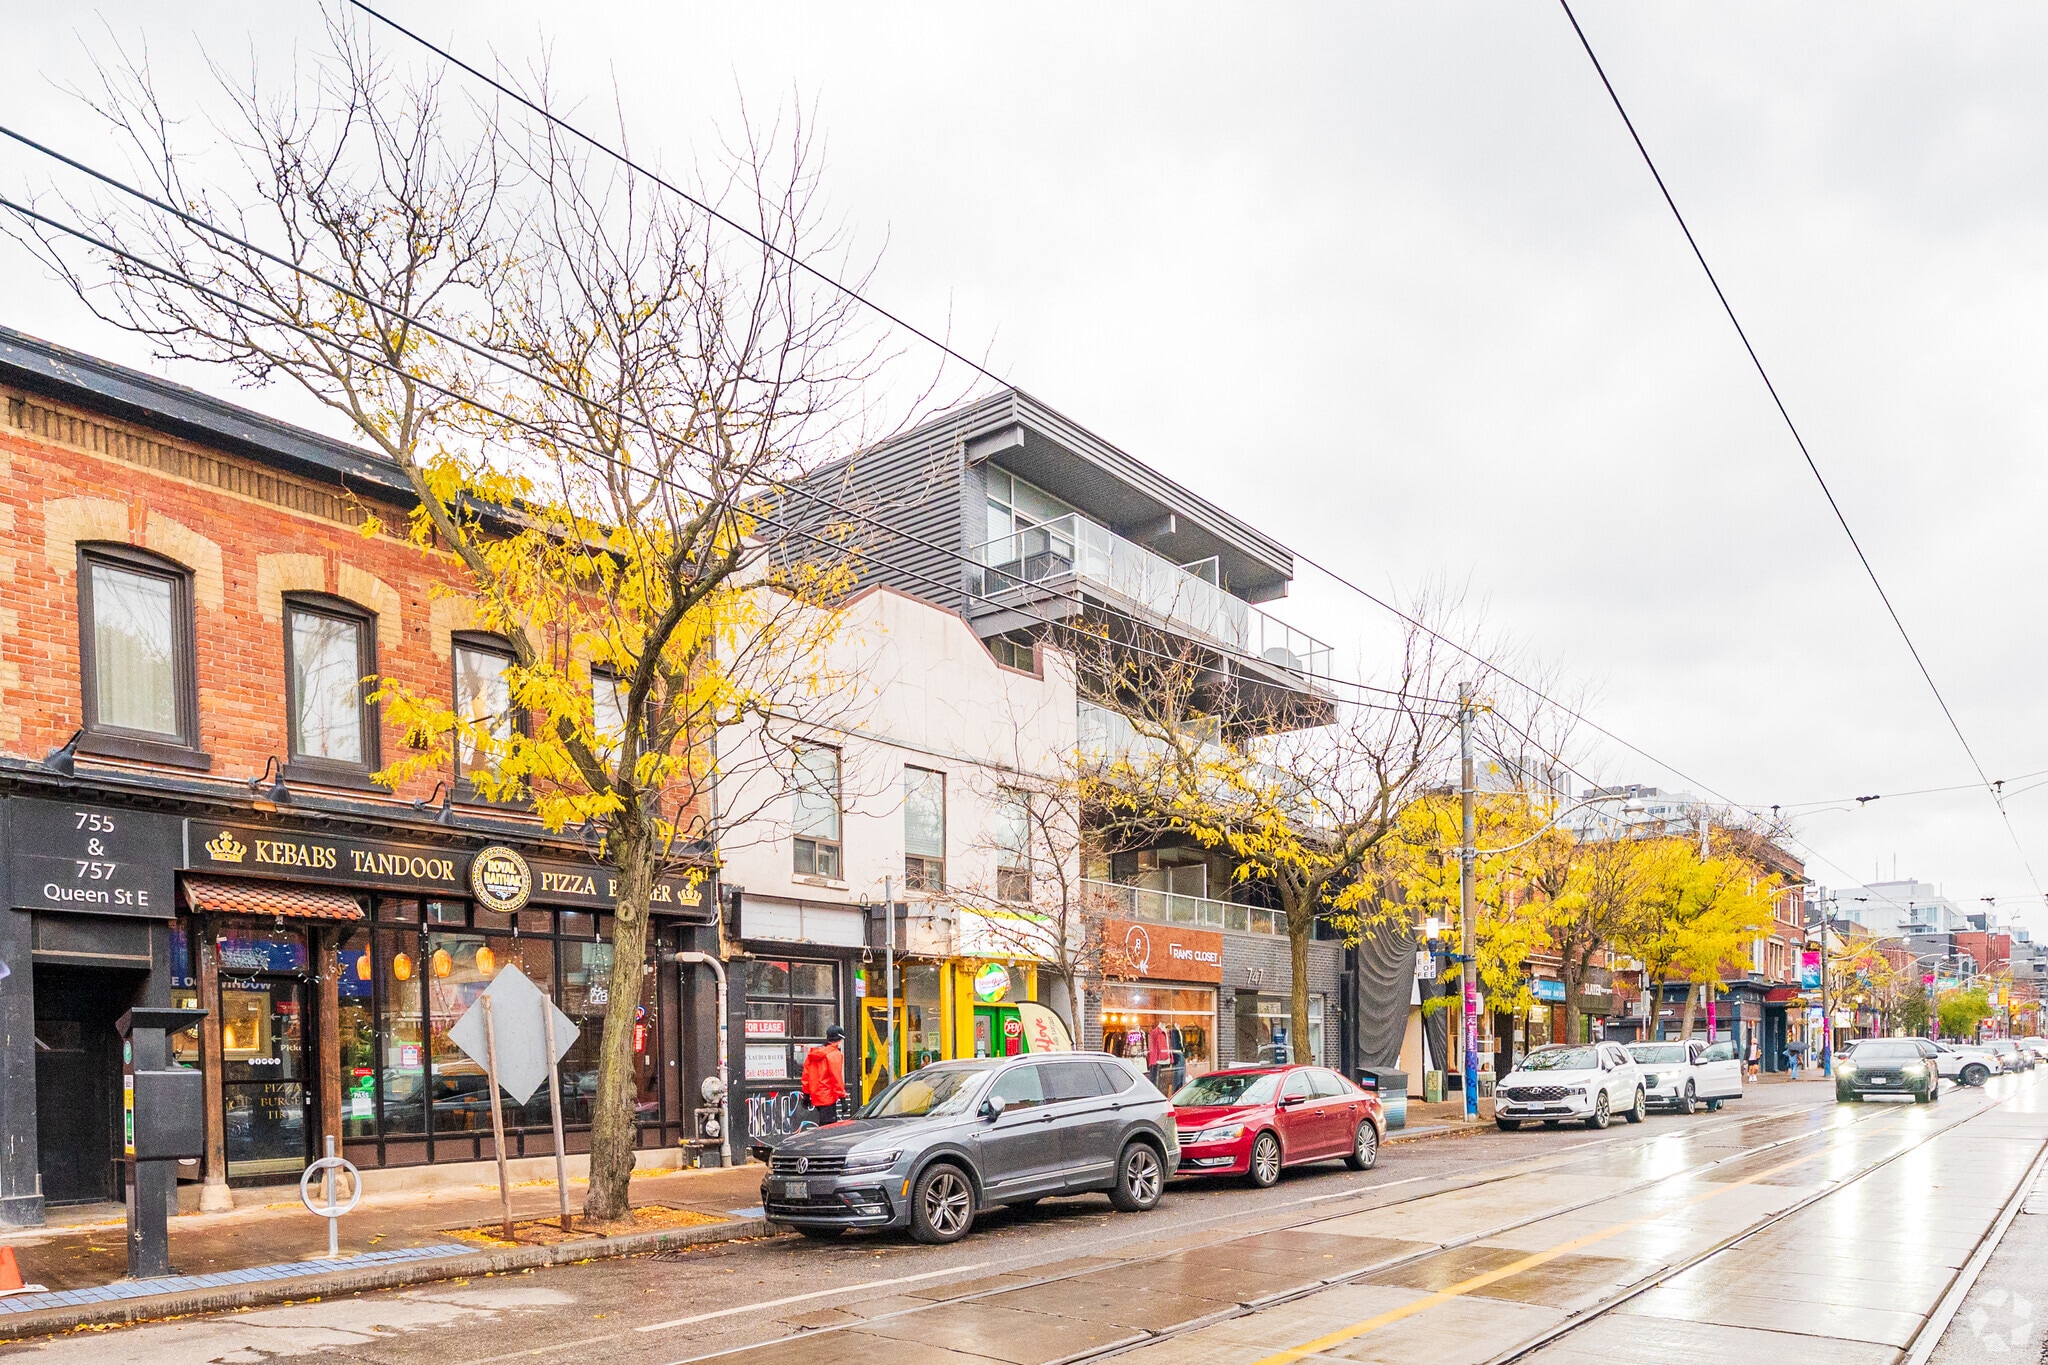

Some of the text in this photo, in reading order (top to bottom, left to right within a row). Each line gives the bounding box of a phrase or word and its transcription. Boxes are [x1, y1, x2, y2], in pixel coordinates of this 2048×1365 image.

[75, 811, 114, 833] 755
[87, 837, 104, 857] &
[255, 839, 455, 881] KEBABS TANDOOR
[487, 859, 517, 874] ROYAL
[76, 860, 116, 880] 757
[484, 871, 522, 887] BAITHAK
[541, 871, 672, 903] PIZZA BER
[43, 883, 149, 906] Queen St E
[1173, 949, 1218, 963] RAN'S CLOSET
[1246, 967, 1264, 986] 747
[745, 1022, 782, 1032] FOR LEASE
[1004, 1020, 1022, 1034] OPEN
[264, 1083, 302, 1094] PIZZA
[353, 1091, 370, 1099] PASS
